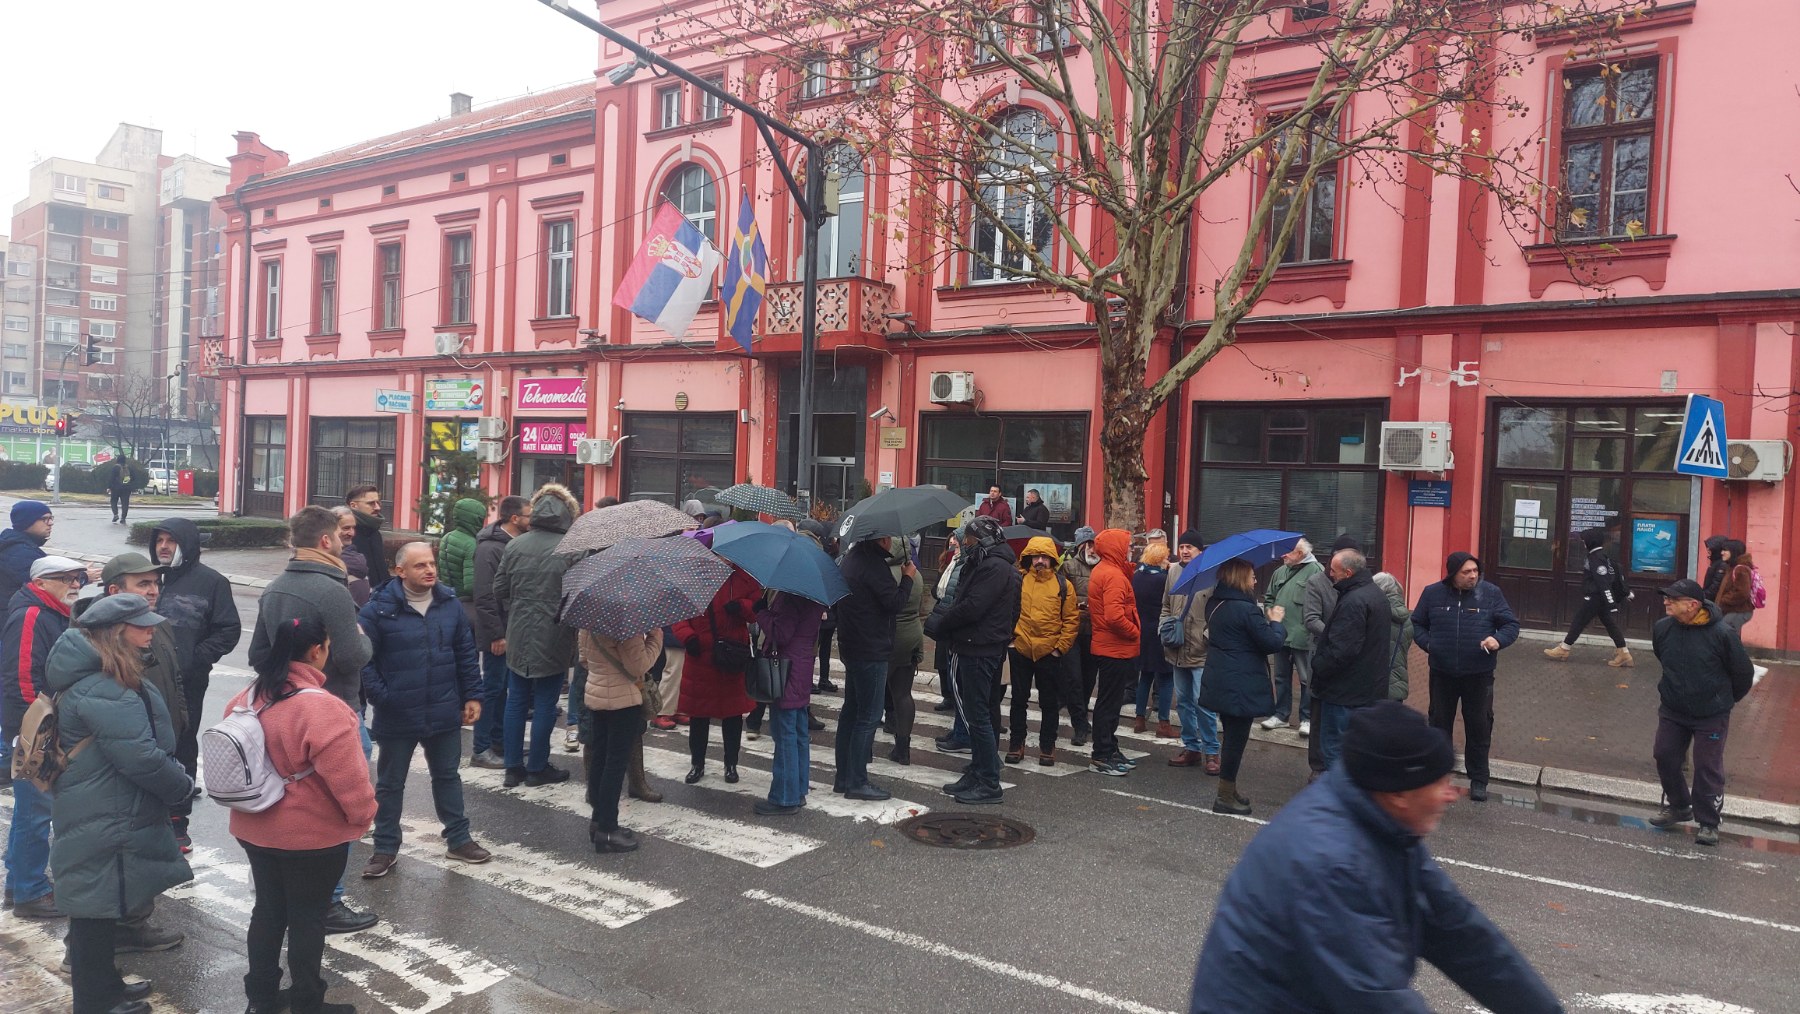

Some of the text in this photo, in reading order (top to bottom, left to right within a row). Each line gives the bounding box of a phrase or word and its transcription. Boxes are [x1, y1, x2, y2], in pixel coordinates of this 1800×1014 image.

[522, 383, 586, 404] Tehnomedia
[0, 404, 57, 425] PLUS
[1, 426, 31, 434] market
[522, 427, 537, 442] 24
[541, 426, 562, 443] 0%
[522, 443, 537, 451] RATE
[540, 443, 562, 451] KAMATE
